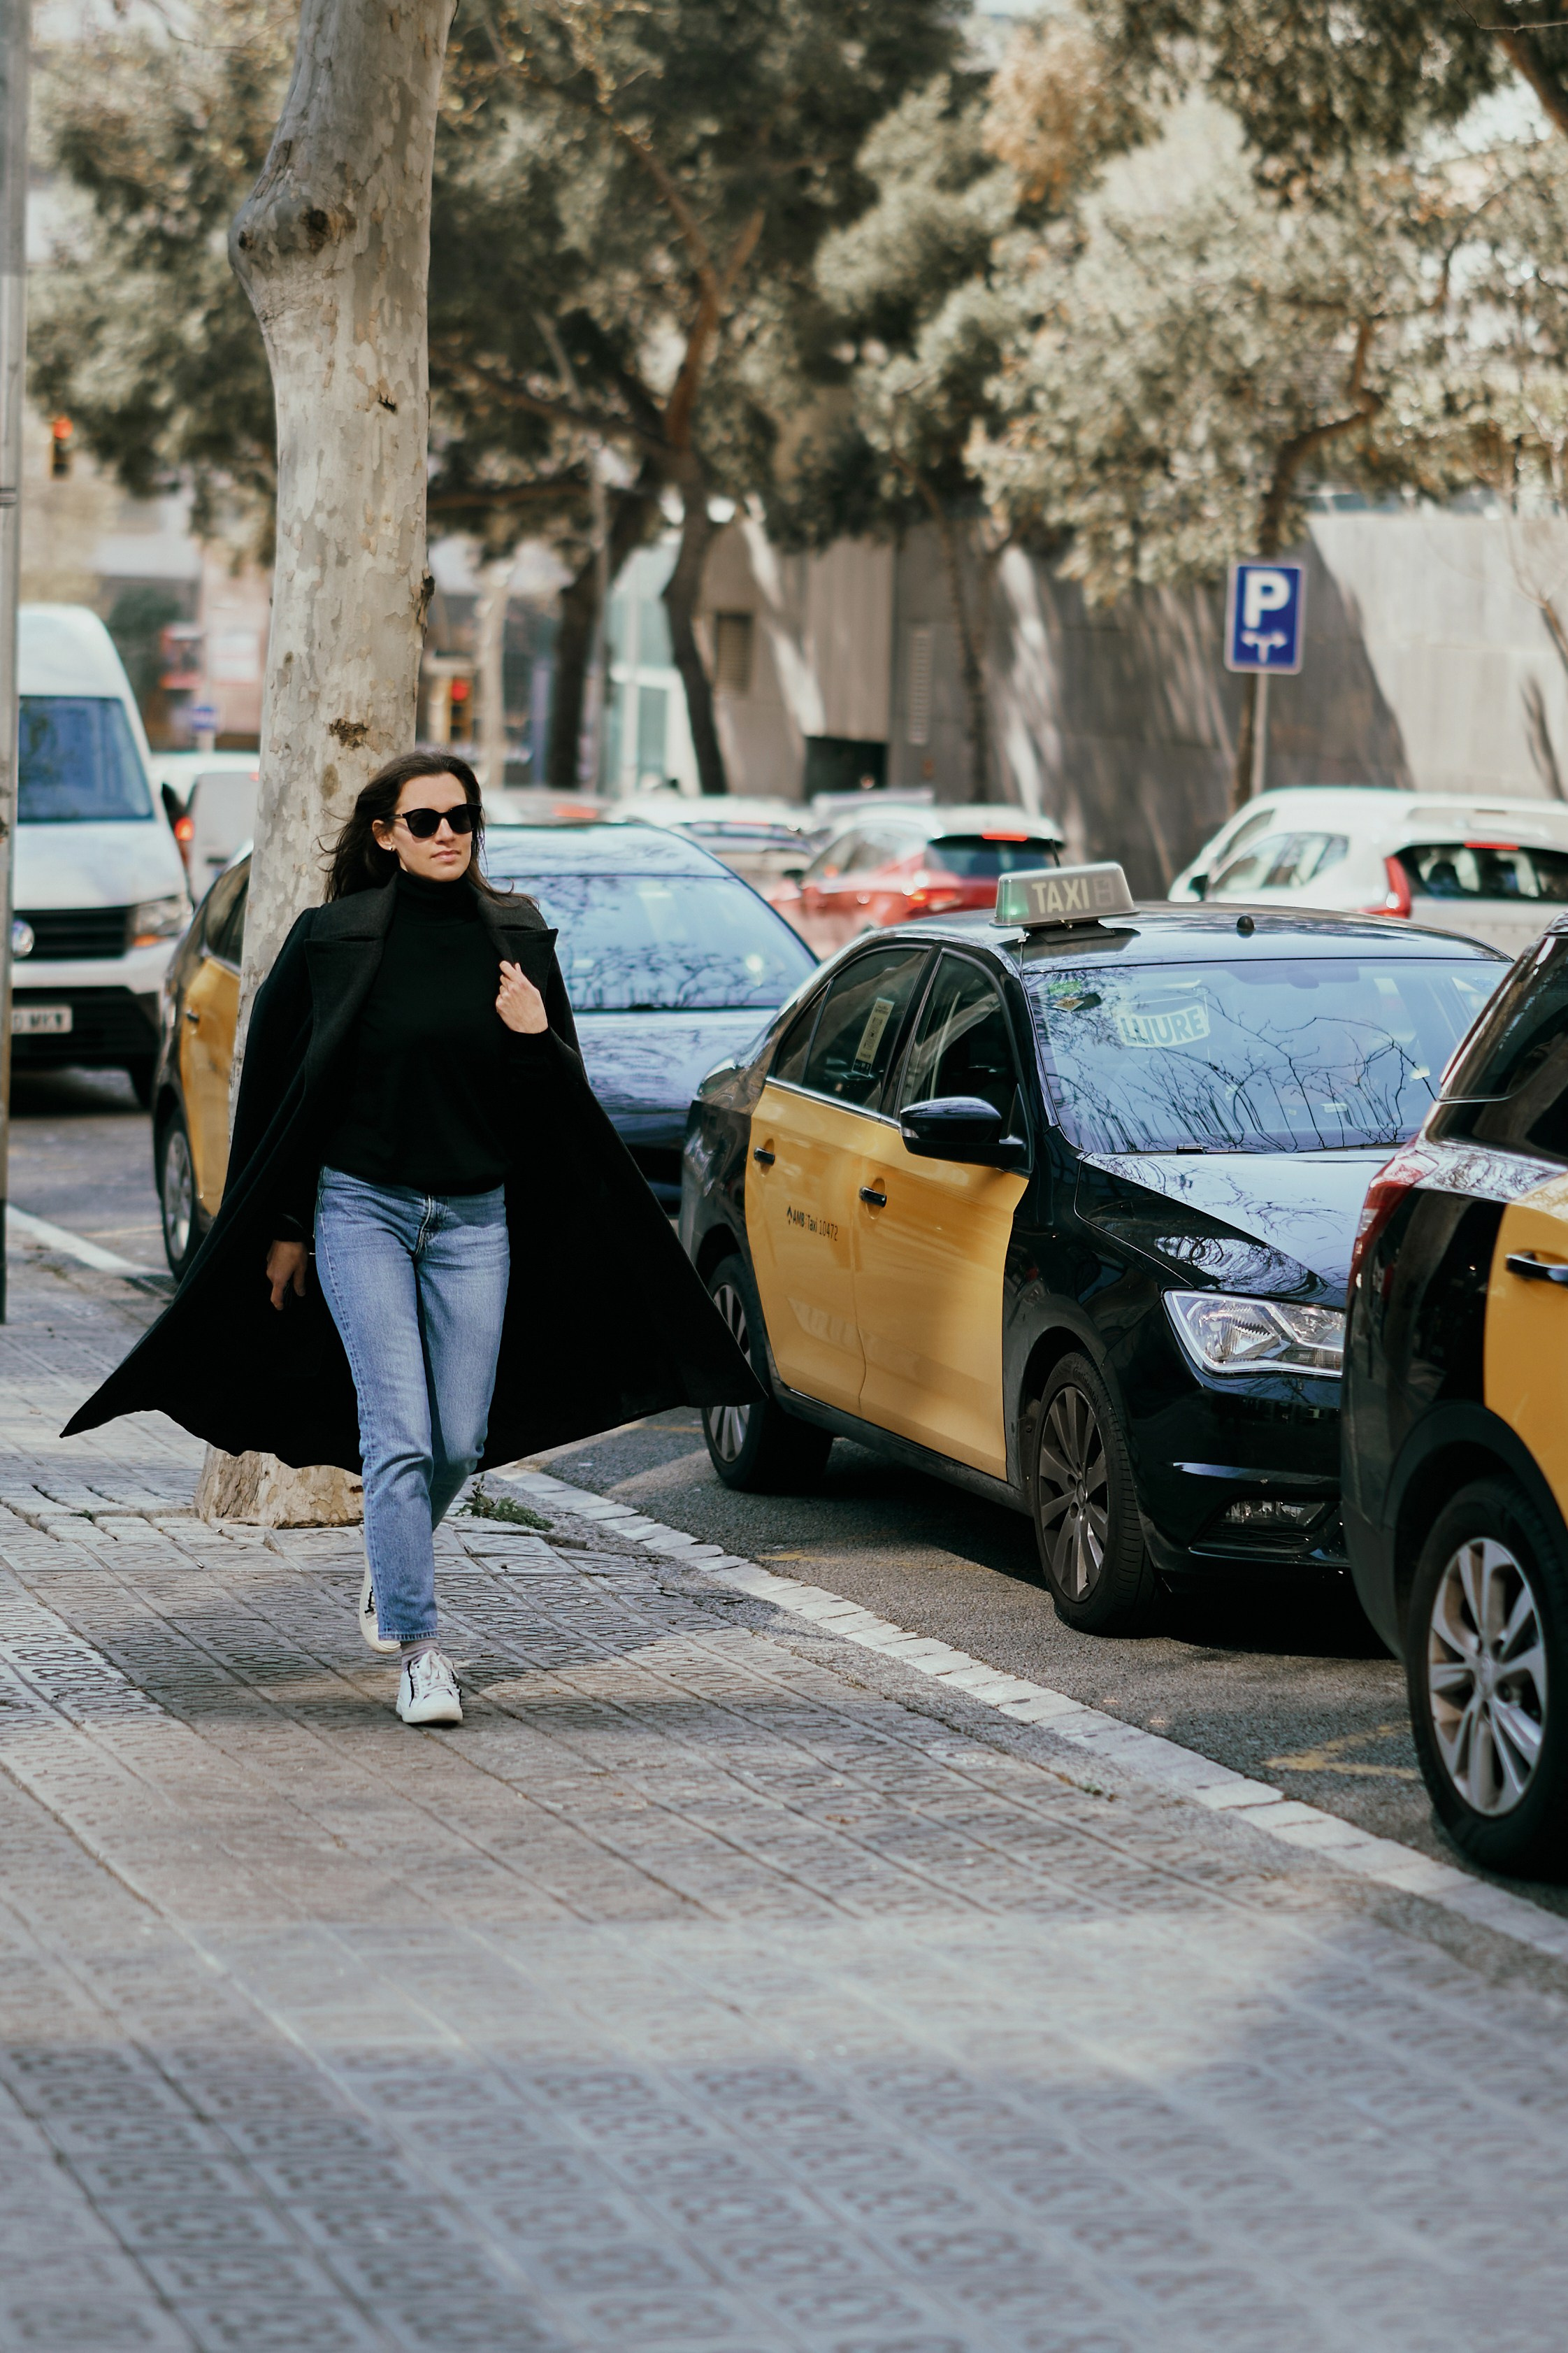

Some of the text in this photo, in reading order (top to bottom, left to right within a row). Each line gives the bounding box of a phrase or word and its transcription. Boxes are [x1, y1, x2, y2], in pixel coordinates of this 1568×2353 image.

[1244, 569, 1290, 629] P
[1031, 878, 1090, 914] TAXI
[1120, 1007, 1204, 1045] LLIURE
[793, 1209, 838, 1241] AMB Taxi 10472
